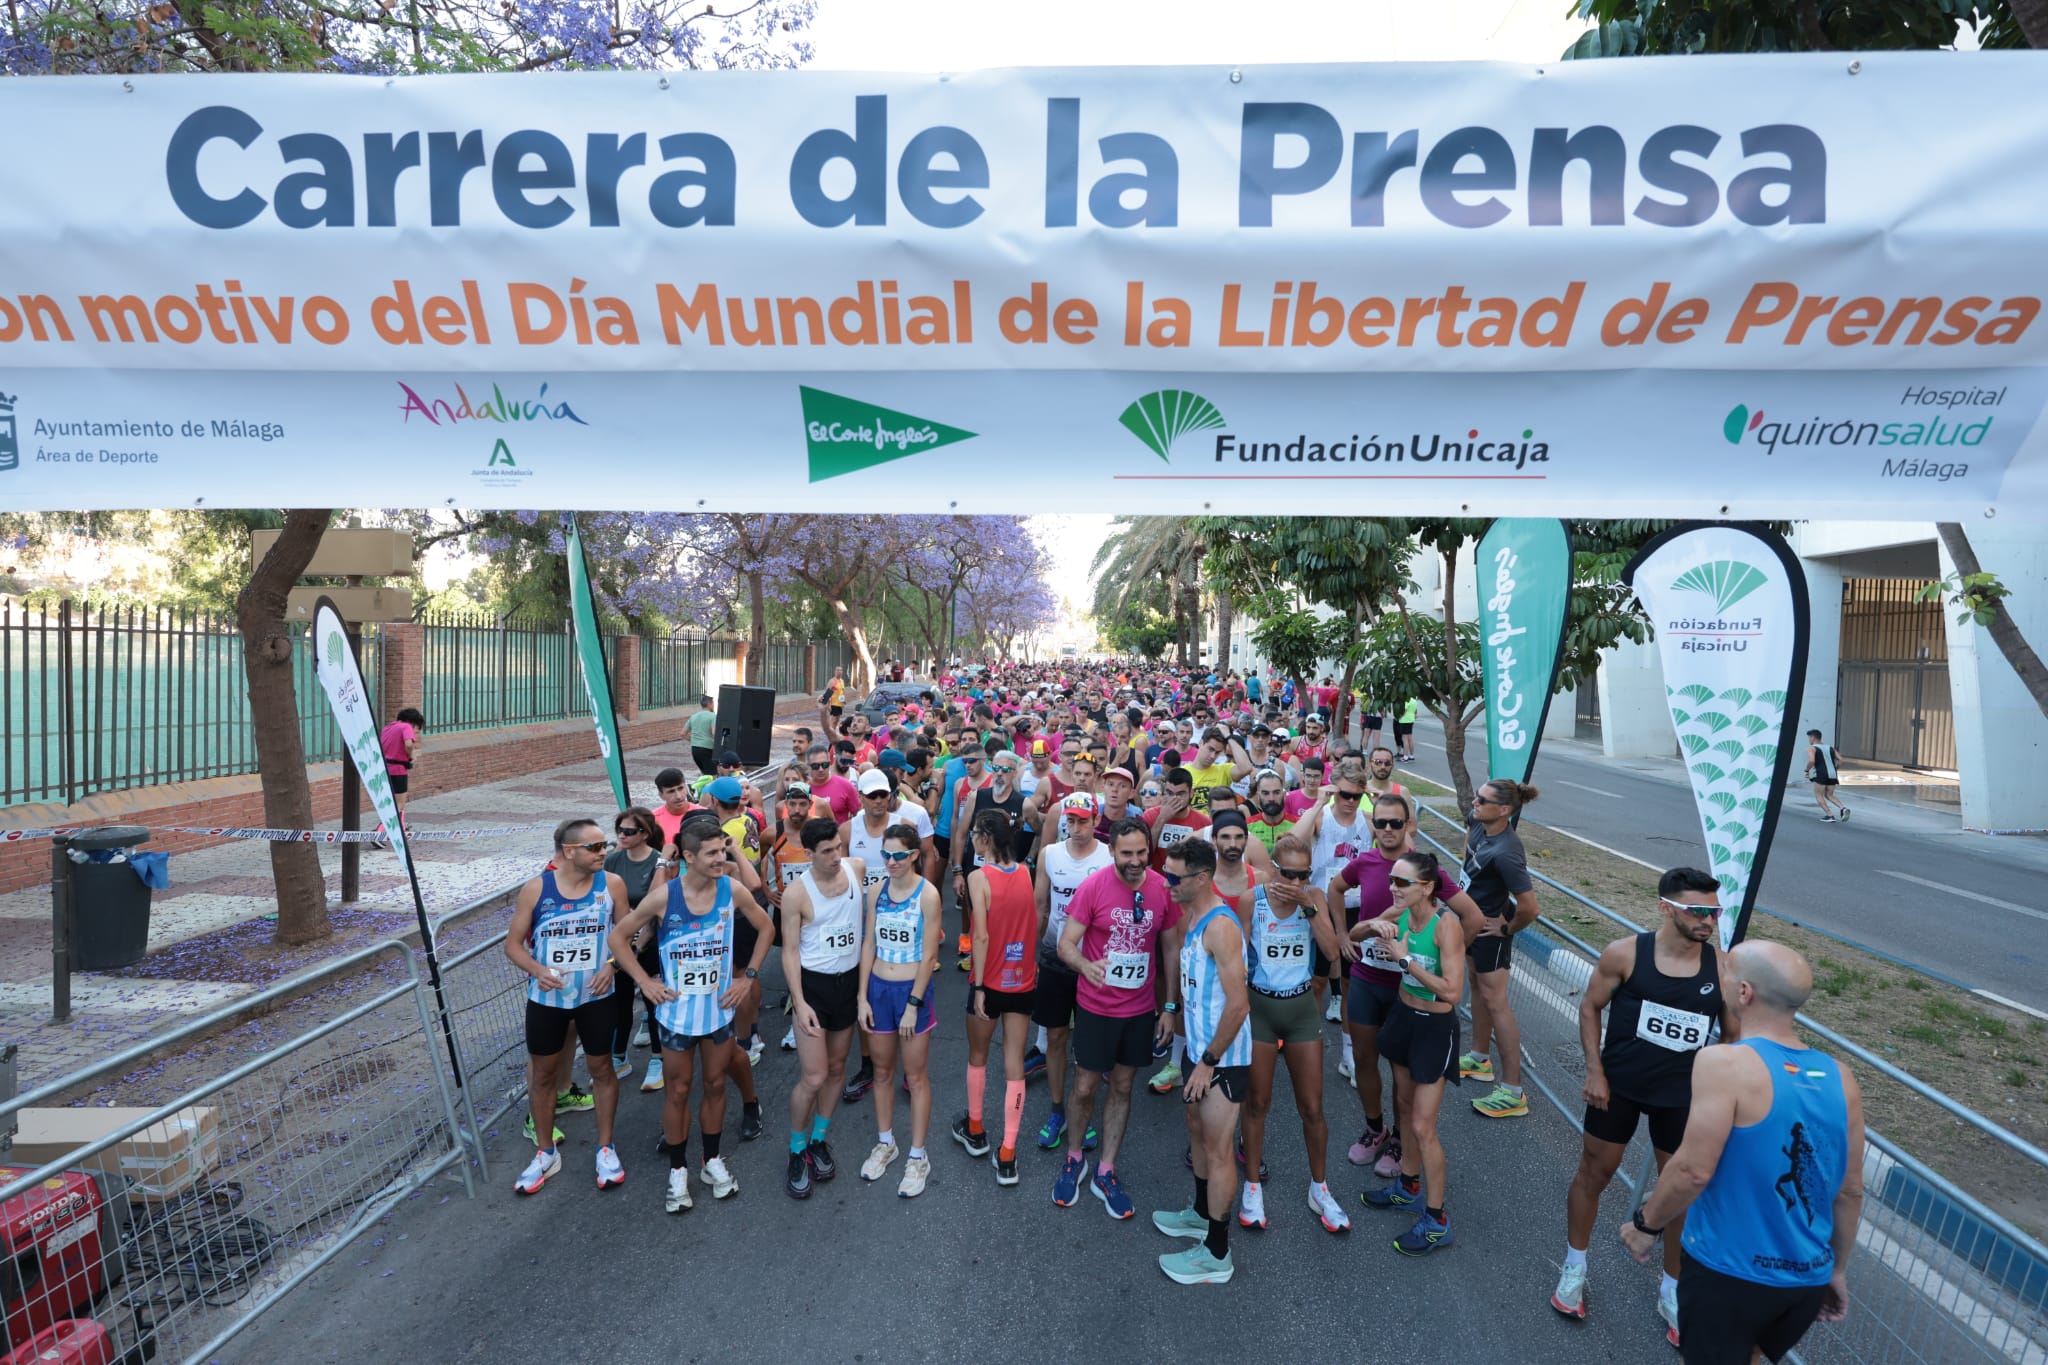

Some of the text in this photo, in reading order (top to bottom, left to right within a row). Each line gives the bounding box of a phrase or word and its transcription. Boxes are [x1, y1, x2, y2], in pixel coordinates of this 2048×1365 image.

[166, 94, 1828, 229] Carrera de la Prensa
[79, 280, 349, 344] motivo
[371, 280, 490, 345] del
[508, 278, 640, 345] Día
[656, 280, 972, 346] Mundial
[999, 282, 1098, 344] de
[1124, 281, 1191, 347] la
[1218, 281, 1586, 347] Libertad
[1602, 282, 1709, 346] de
[1725, 282, 2041, 346] Prensa
[397, 381, 590, 426] Andalucía
[1900, 387, 2007, 410] Hospital
[34, 418, 285, 442] Ayuntamiento de Málaga
[808, 418, 938, 450] El Corte Inglés
[1757, 415, 1994, 455] quirónsalud
[36, 446, 159, 465] Área de Deporte
[1881, 458, 1968, 481] Málaga
[548, 917, 598, 927] ATLETISMO
[540, 924, 606, 938] MÁLAGA
[879, 927, 910, 943] 658
[678, 939, 723, 949] ATLETISMO
[826, 932, 855, 948] 136
[552, 948, 592, 964] 675
[669, 945, 729, 961] MÁLAGA
[1266, 944, 1304, 958] 676
[684, 970, 718, 986] 210
[1111, 965, 1146, 980] 472
[1274, 984, 1304, 998] NIKE
[1646, 1017, 1700, 1044] 668
